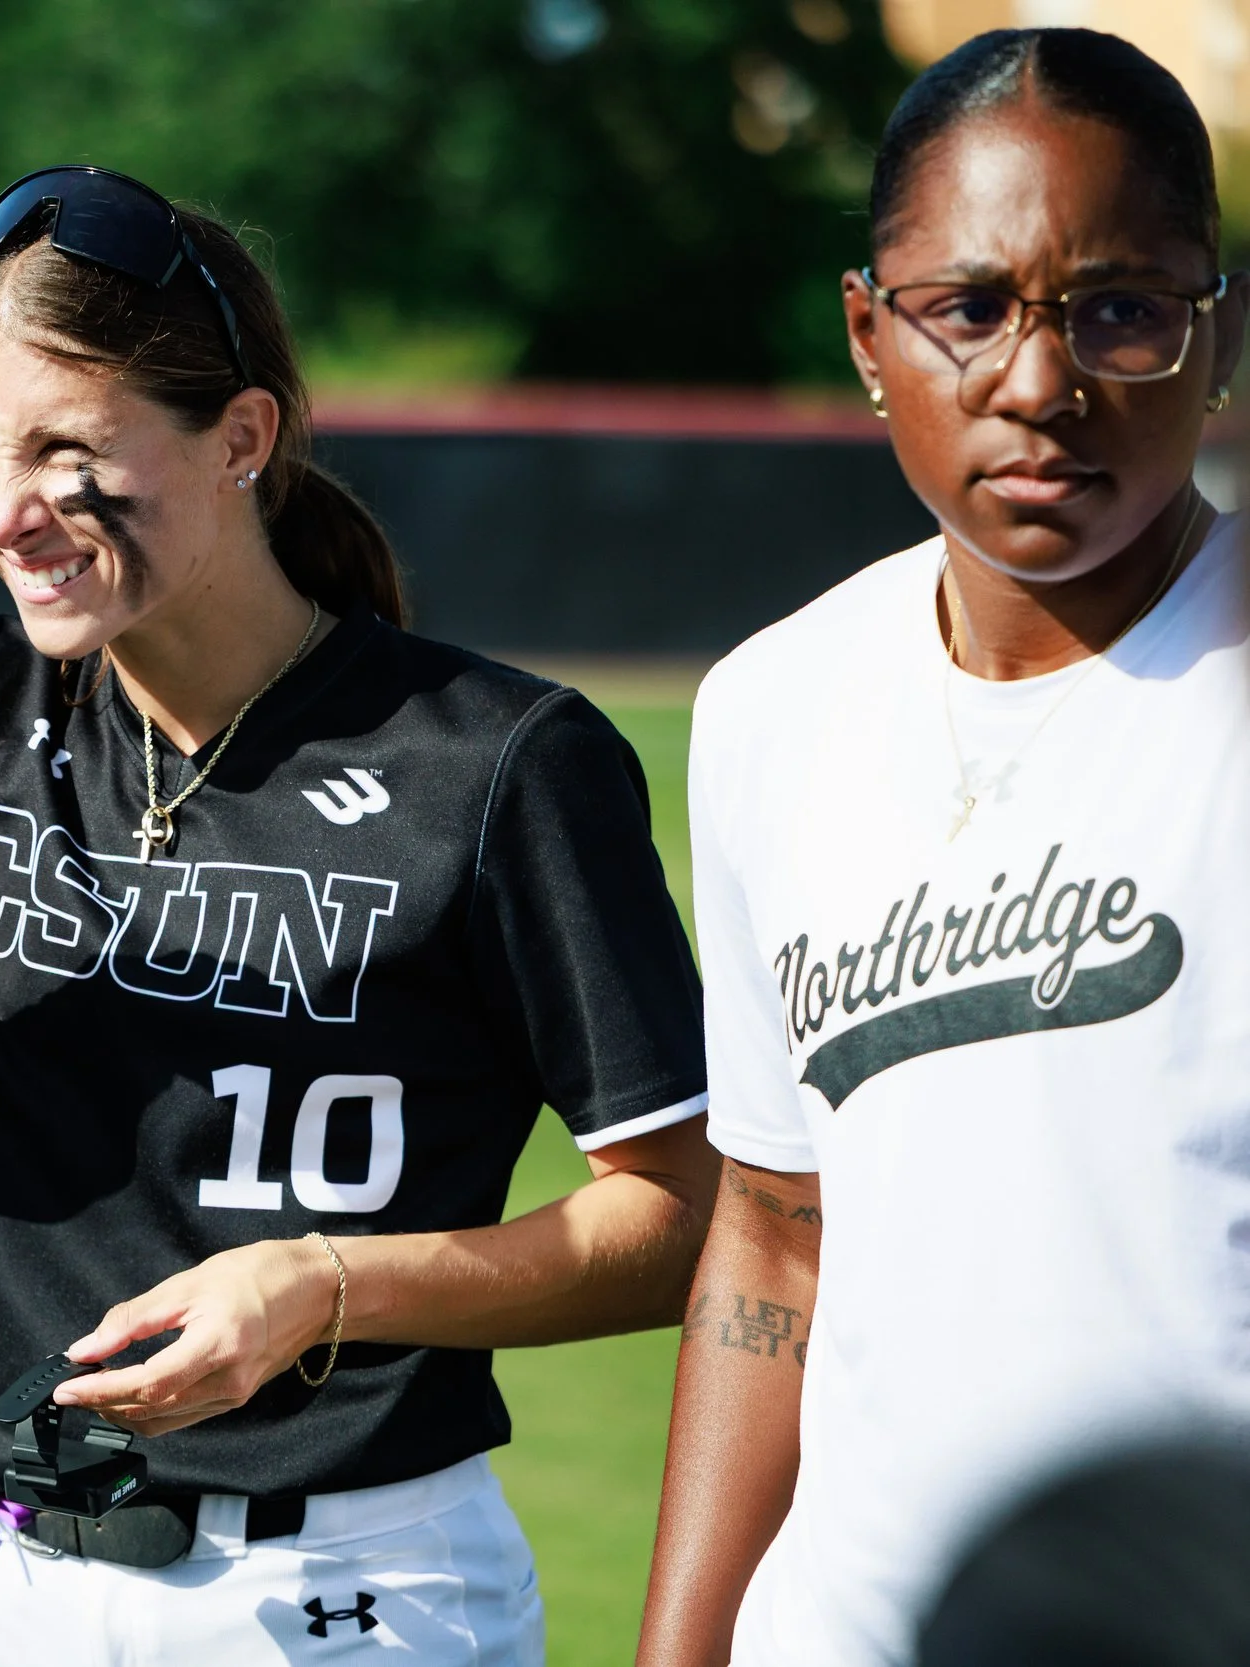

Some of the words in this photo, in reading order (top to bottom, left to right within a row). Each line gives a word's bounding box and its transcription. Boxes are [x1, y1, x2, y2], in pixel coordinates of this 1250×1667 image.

[774, 843, 1152, 1056] Northridge
[198, 1063, 404, 1214] 10
[733, 1294, 802, 1340] LET
